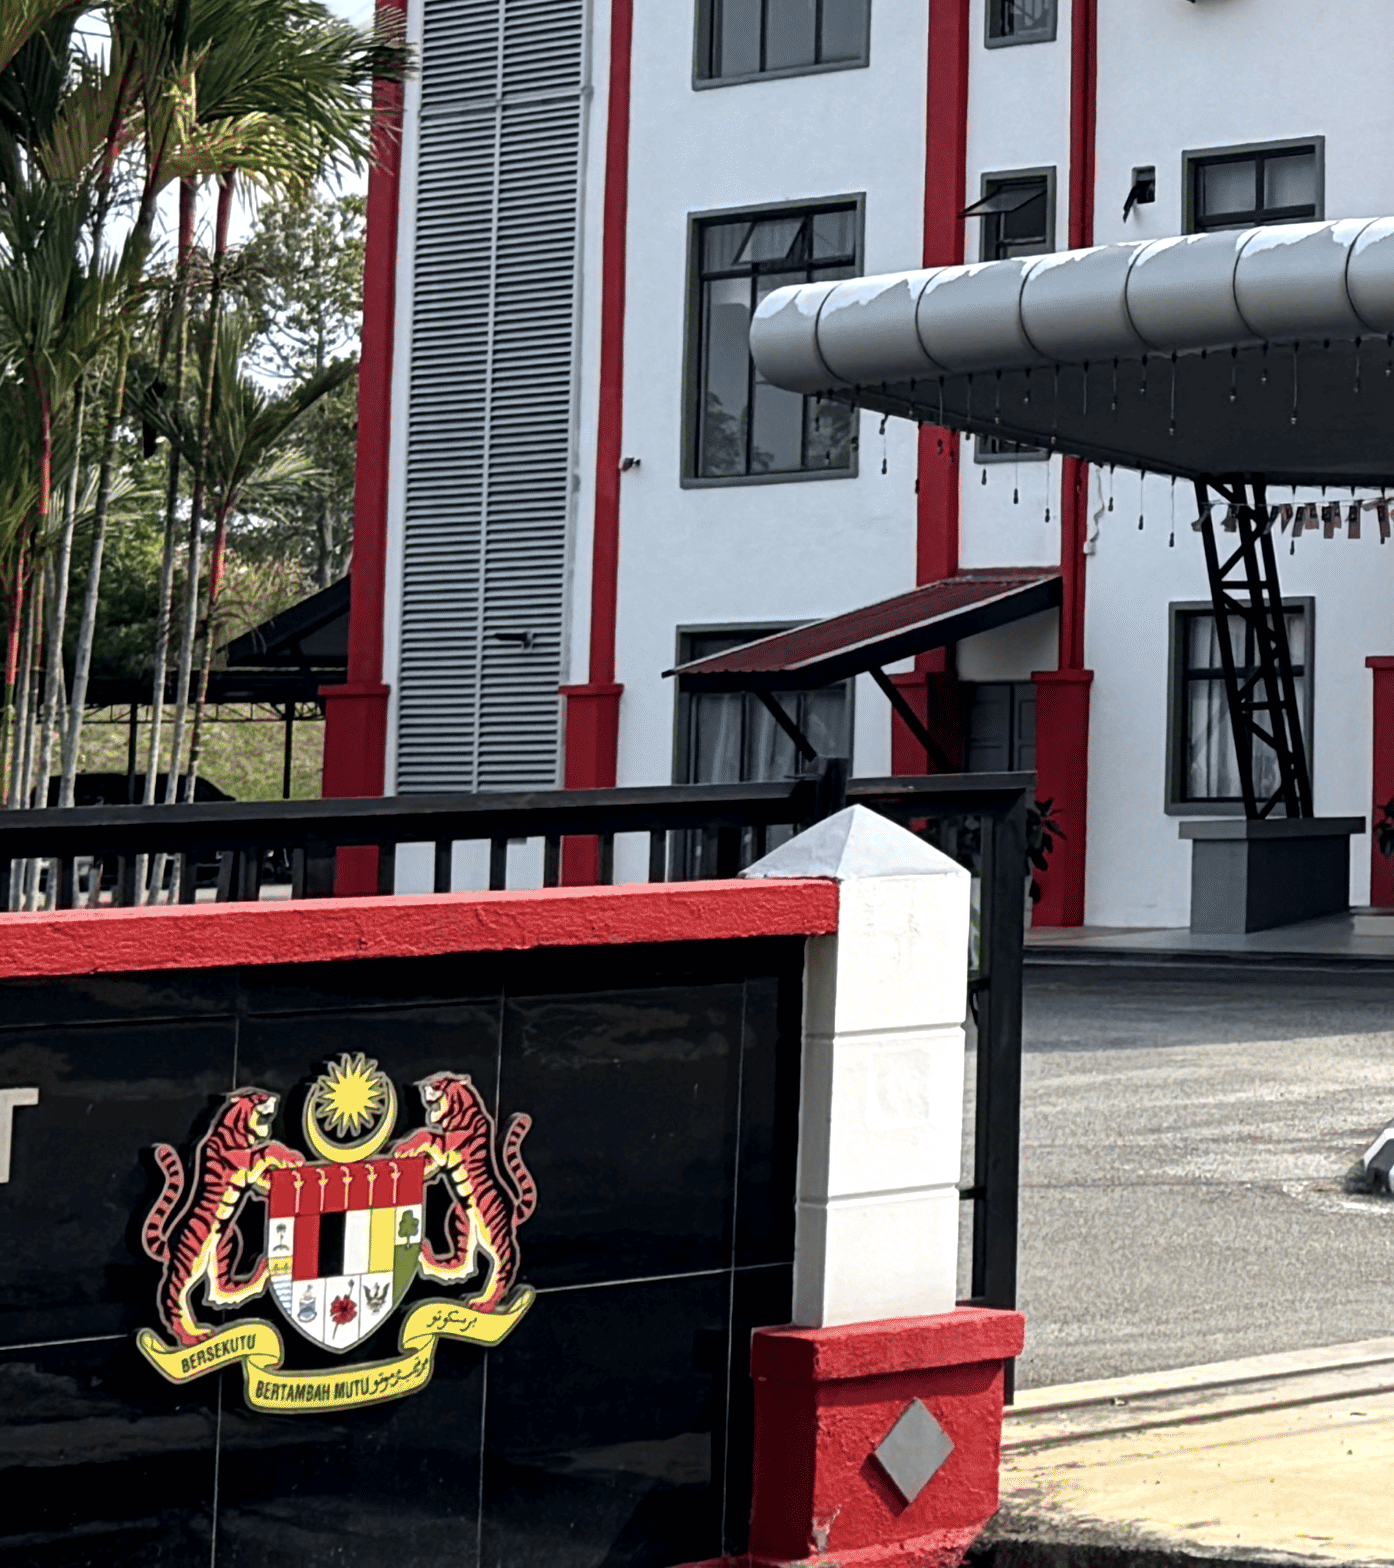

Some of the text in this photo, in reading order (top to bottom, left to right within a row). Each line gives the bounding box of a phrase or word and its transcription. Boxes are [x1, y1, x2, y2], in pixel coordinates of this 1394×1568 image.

[180, 1333, 257, 1373] BERSEKUTU
[255, 1377, 370, 1402] BERTAMBAH MUTU
